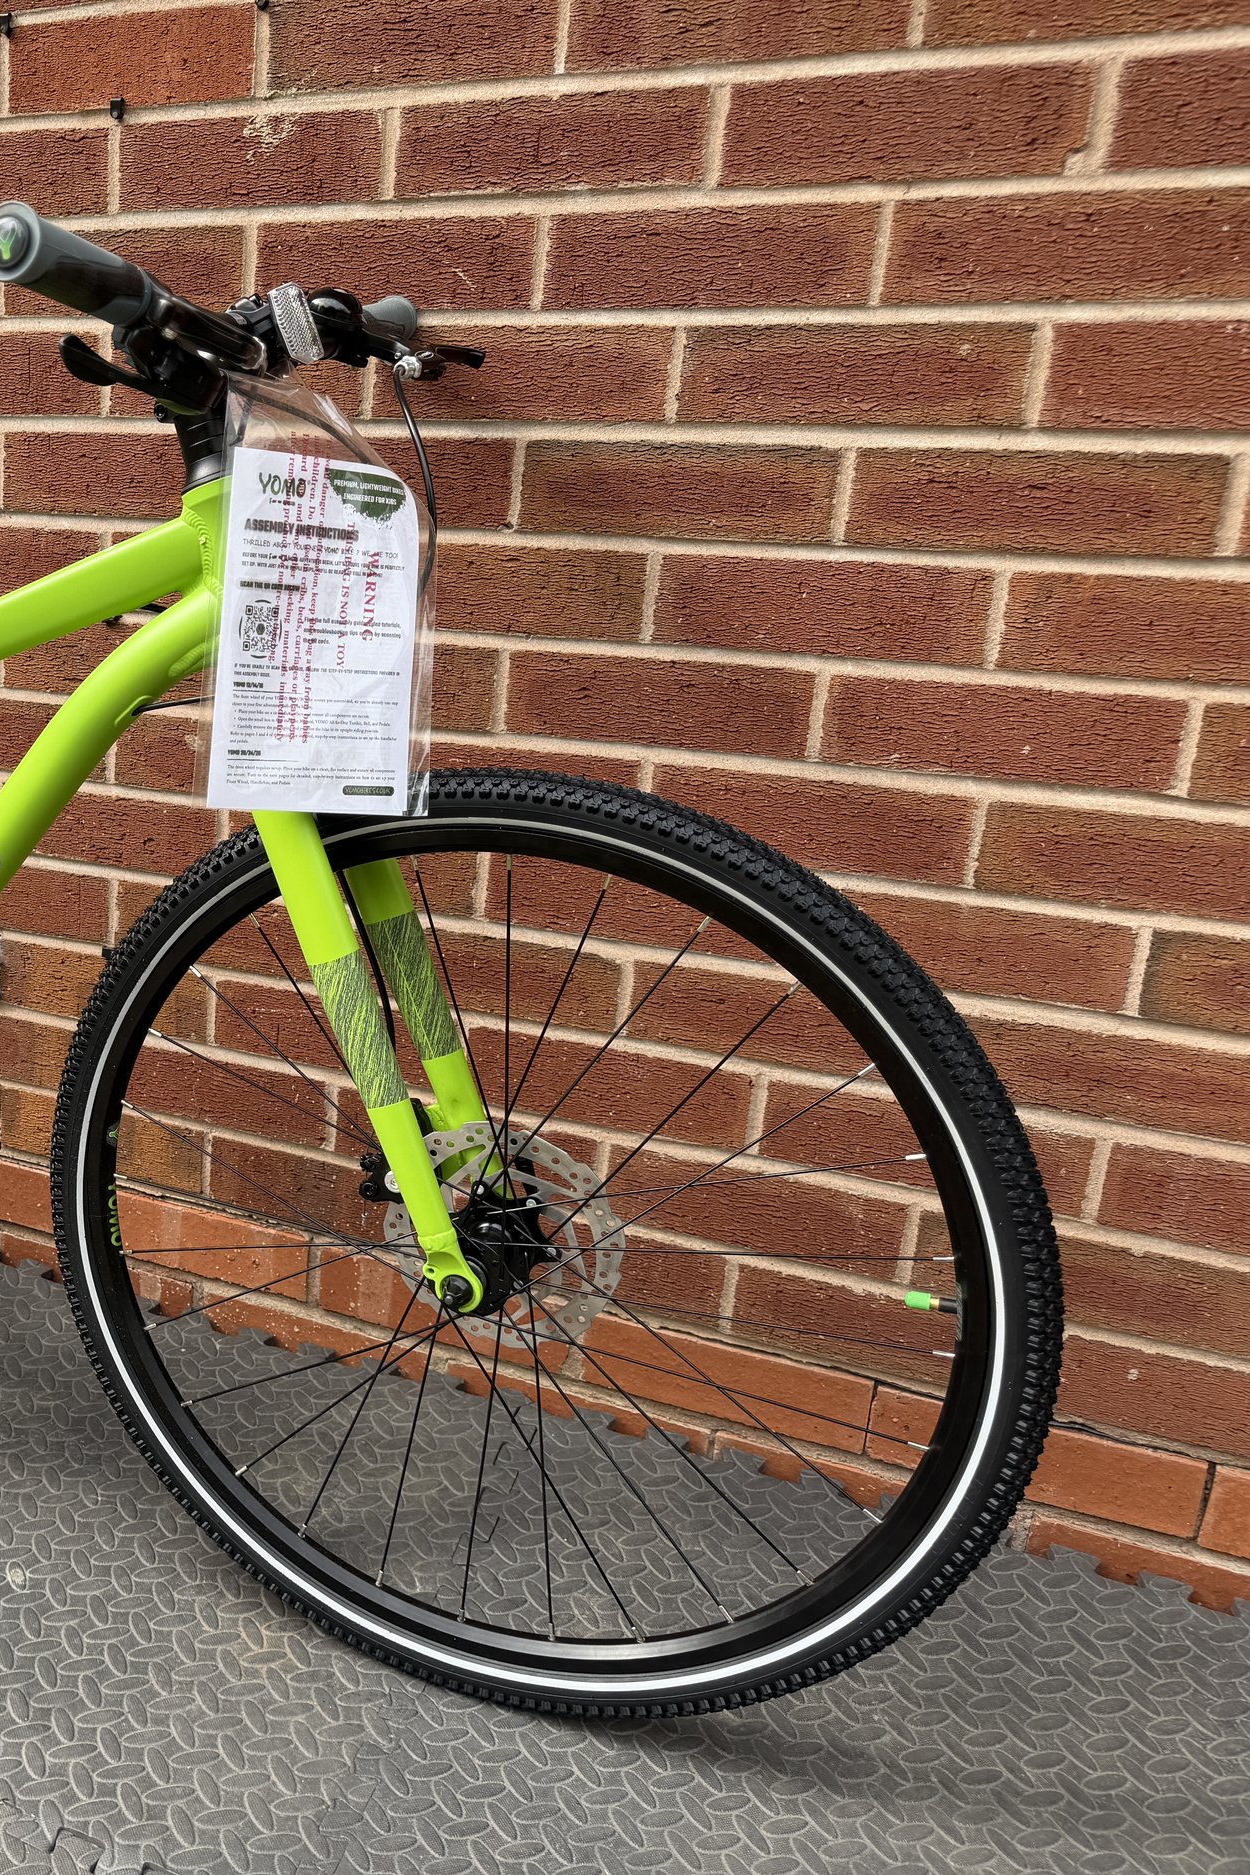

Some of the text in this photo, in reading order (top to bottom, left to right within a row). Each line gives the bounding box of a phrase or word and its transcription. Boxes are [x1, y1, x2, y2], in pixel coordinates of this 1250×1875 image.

[258, 472, 307, 498] YOMO
[309, 457, 320, 502] children.
[307, 505, 316, 520] Do
[319, 482, 330, 518] danger
[244, 518, 359, 542] ASSEMBLY INSTRUCTIONS
[298, 577, 308, 603] cribs,
[309, 592, 319, 614] keep
[341, 585, 350, 598] IS
[362, 551, 380, 641] WARNING
[295, 606, 306, 632] beds,
[338, 601, 349, 628] NOT
[292, 635, 302, 680] carriages
[336, 643, 346, 669] TOY
[291, 683, 298, 694] or
[303, 686, 312, 710] from
[301, 713, 311, 744] babies
